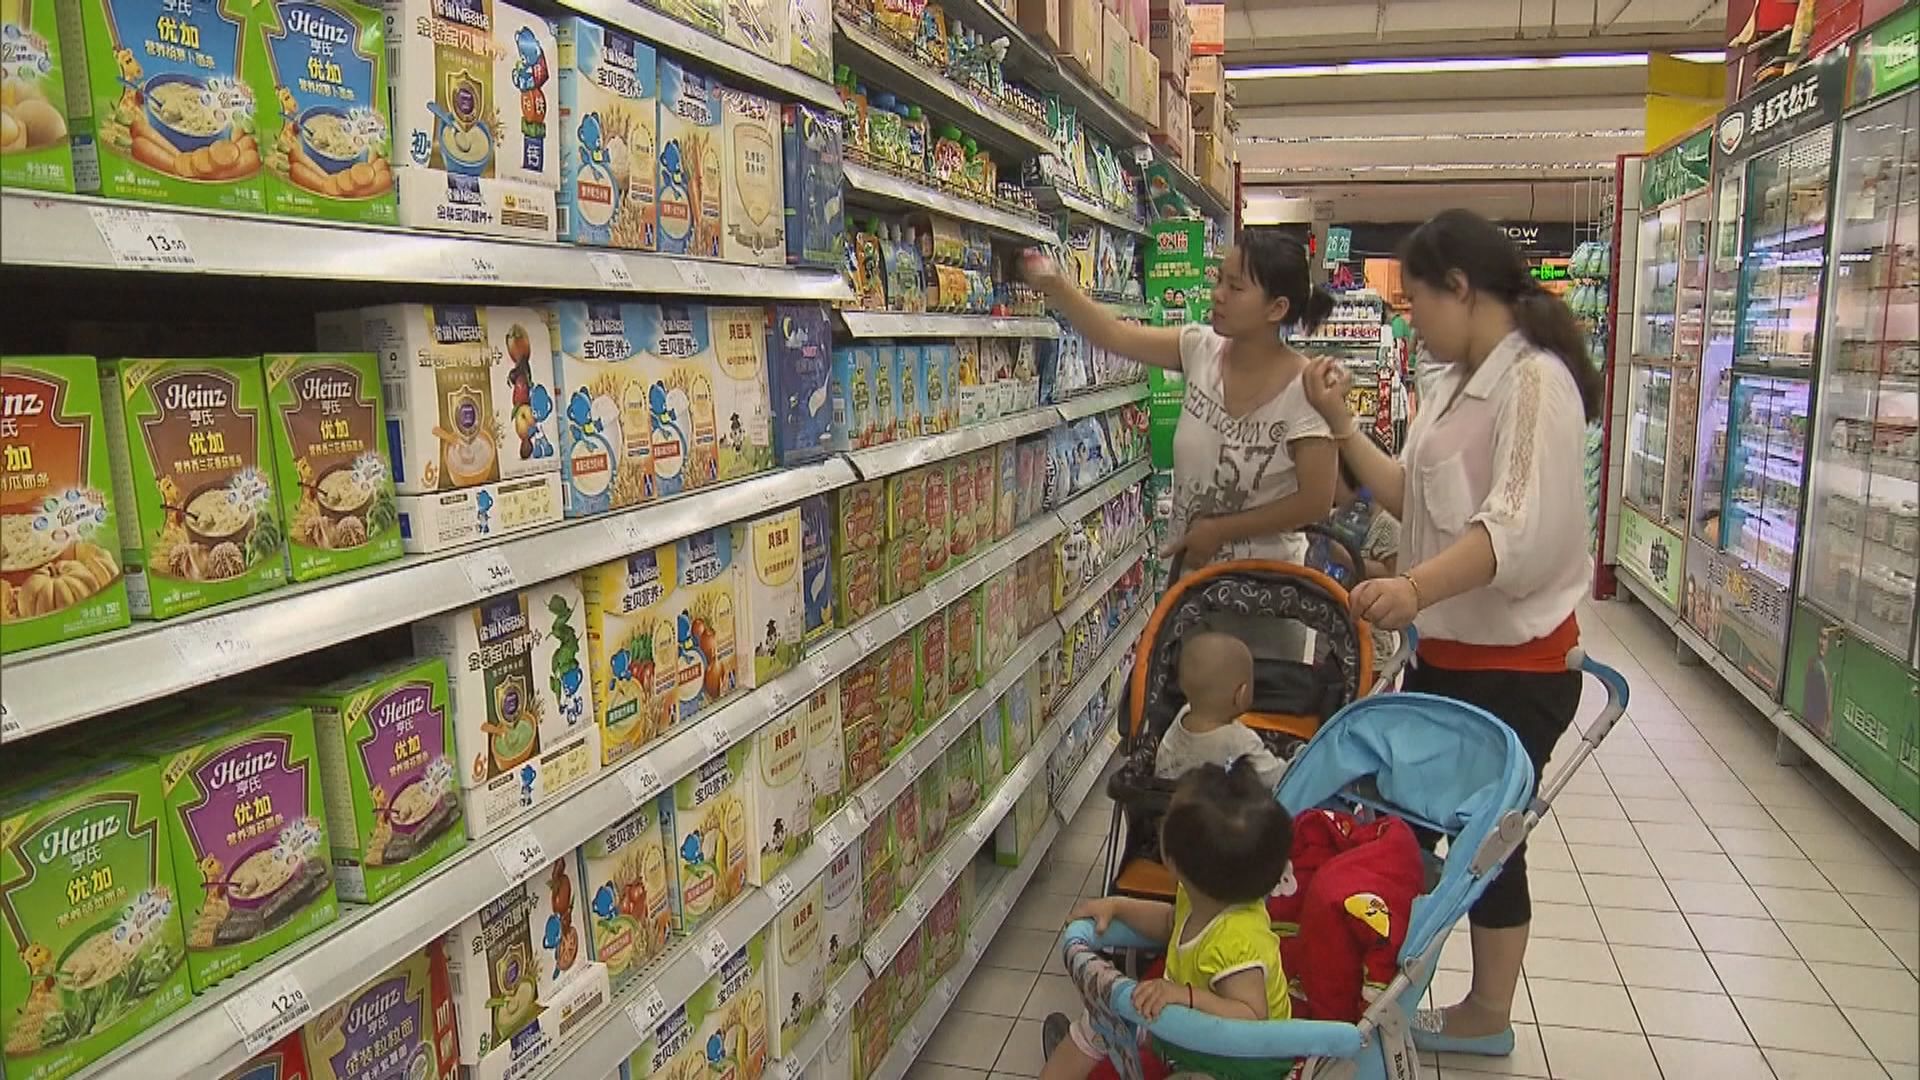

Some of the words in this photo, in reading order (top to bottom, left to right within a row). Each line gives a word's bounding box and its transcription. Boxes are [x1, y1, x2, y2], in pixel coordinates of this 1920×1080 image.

[158, 15, 200, 49] 优加
[288, 9, 348, 44] Heinz
[310, 38, 334, 57] 亨氏
[308, 56, 342, 85] 优加
[584, 339, 631, 360] 宝贝营养+
[165, 383, 227, 410] Heinz
[302, 377, 352, 400] Heinz
[189, 409, 215, 427] 亨氏
[321, 400, 342, 416] 亨氏
[189, 431, 225, 455] 优加
[320, 418, 349, 440] 优加
[378, 696, 425, 728] Heinz
[394, 735, 422, 761] 优加
[210, 750, 278, 790] Heinz
[236, 775, 262, 799] 亨氏
[233, 795, 272, 828] 优加
[39, 815, 121, 864] Heinz
[70, 844, 101, 874] 亨氏
[66, 866, 113, 906] 优加
[347, 988, 400, 1033] Heinz
